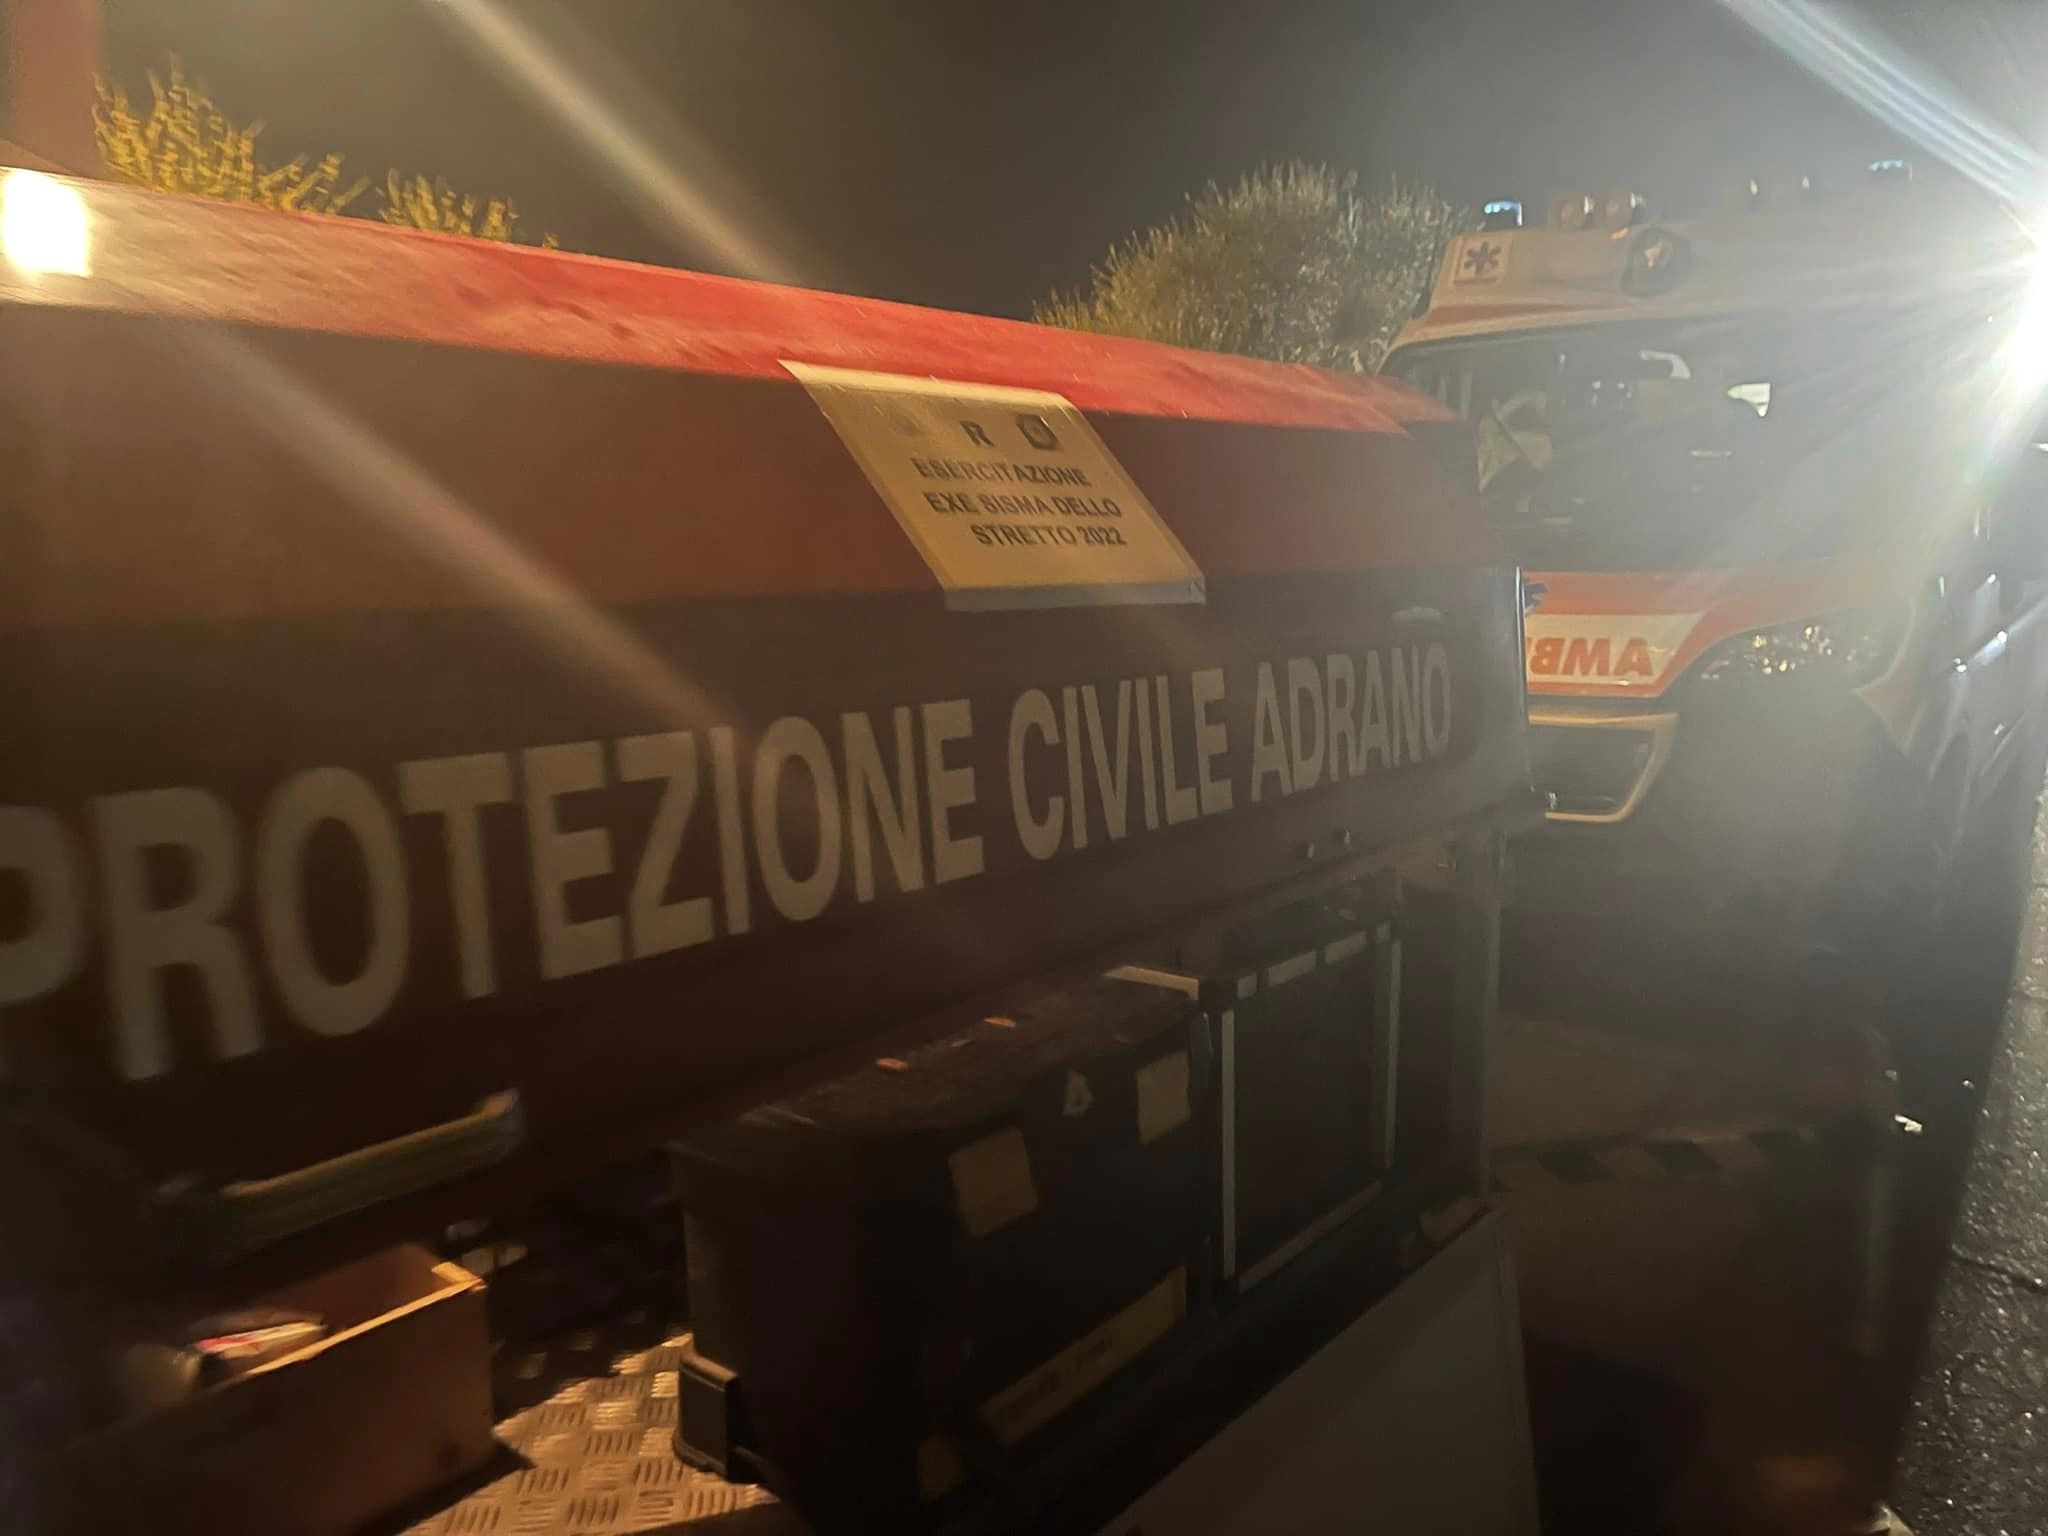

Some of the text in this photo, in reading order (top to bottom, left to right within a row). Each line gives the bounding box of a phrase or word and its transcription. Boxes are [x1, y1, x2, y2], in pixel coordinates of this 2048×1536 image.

[910, 457, 1091, 487] ESERCITAZIONE
[922, 491, 1122, 518] EXE SISMA DELLO
[970, 524, 1126, 547] STRETTO 2022
[1008, 667, 1234, 861] CIVILE
[1250, 641, 1452, 802] ADRANO
